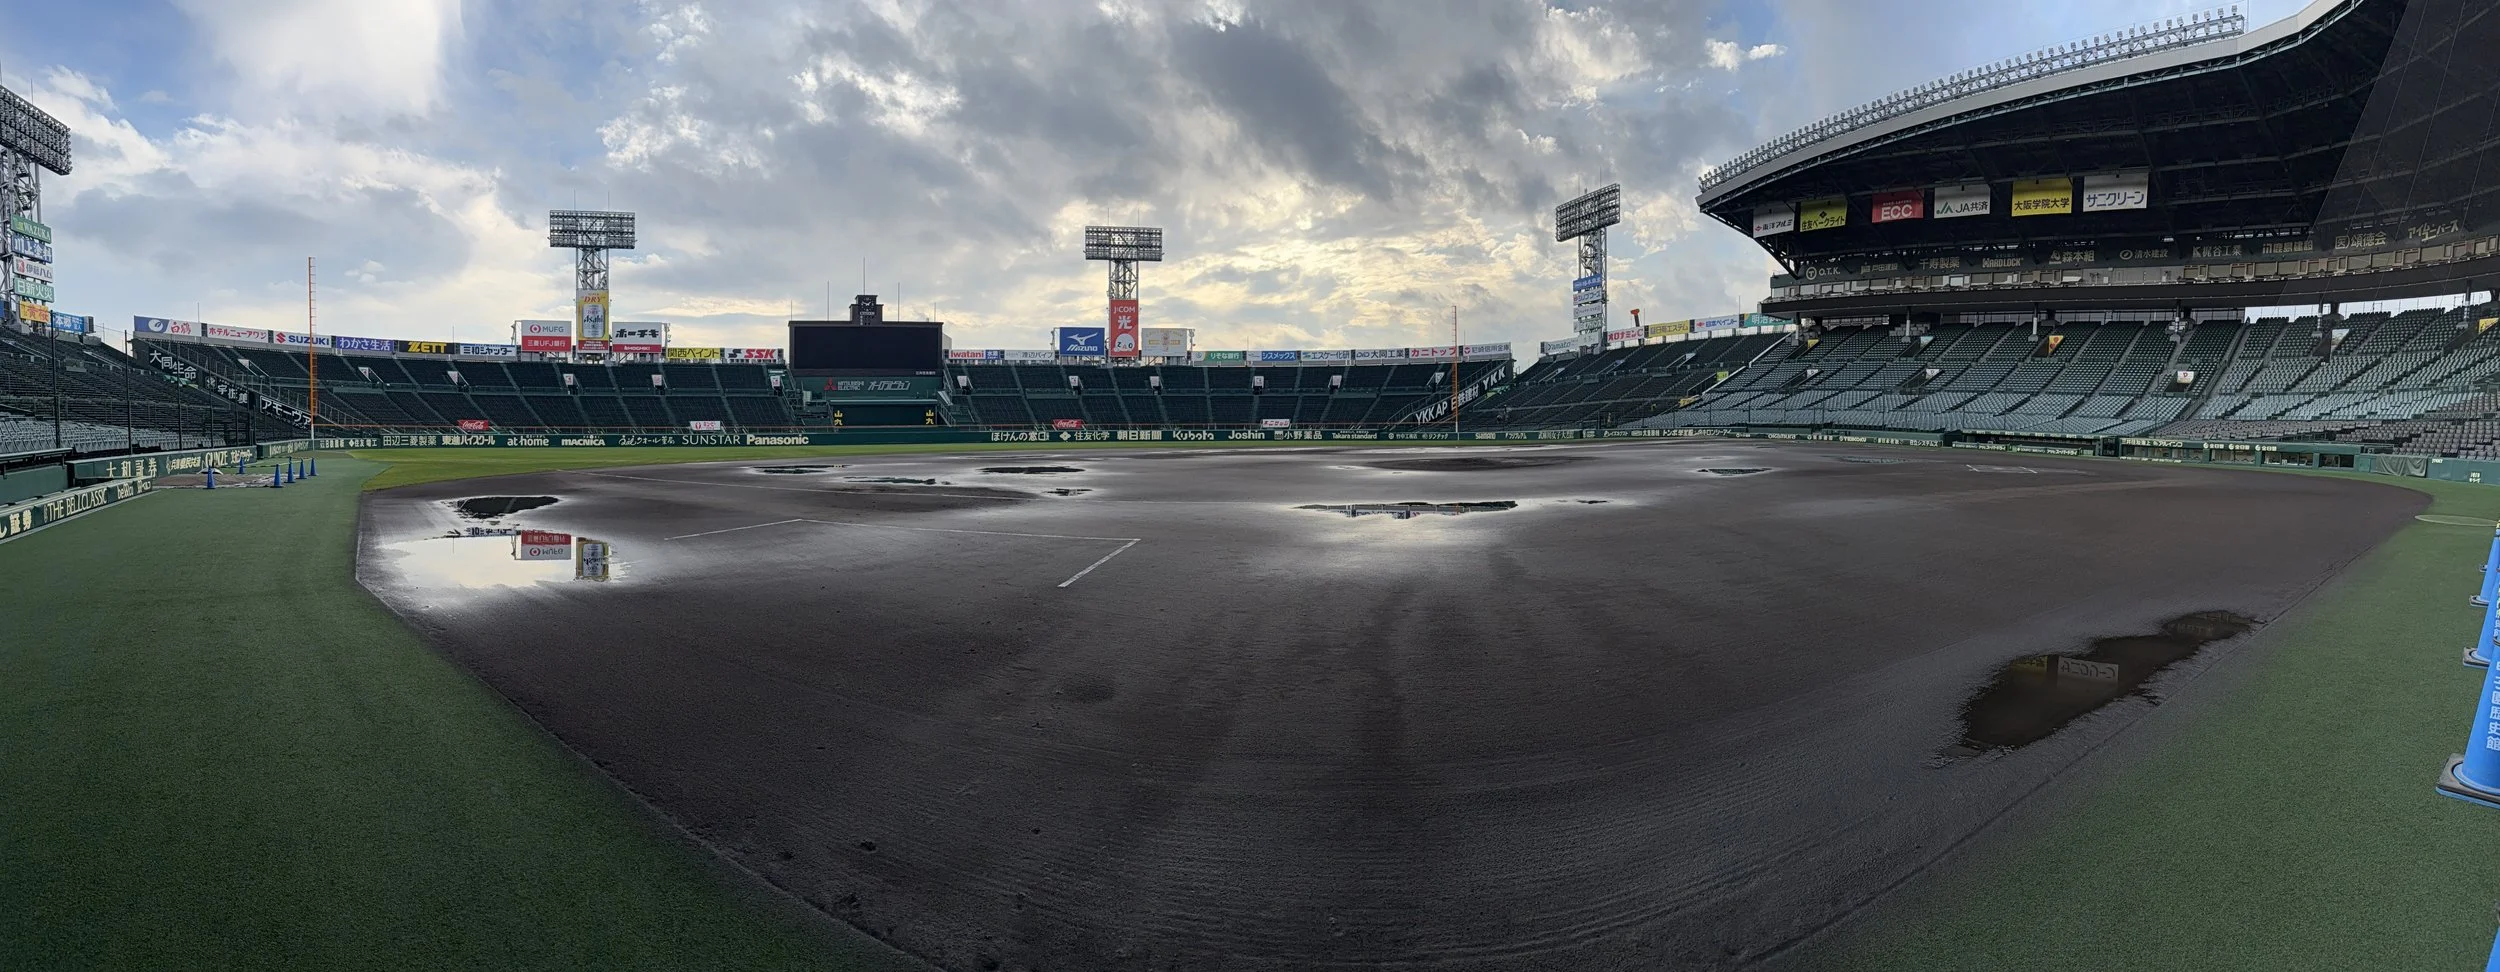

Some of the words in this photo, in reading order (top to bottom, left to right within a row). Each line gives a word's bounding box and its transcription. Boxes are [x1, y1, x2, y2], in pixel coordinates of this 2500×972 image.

[2014, 198, 2070, 211] 大阪学院大学
[2086, 191, 2144, 207] サニクリーン
[1881, 205, 1912, 220] ECC
[1955, 201, 1988, 213] JA共済
[1762, 219, 1792, 231] 東洋アルミ
[1801, 217, 1844, 231] 住友ベークライト
[2062, 250, 2095, 263] 森本組
[2134, 247, 2169, 259] 清水建設
[1872, 262, 1897, 273] 戸田建設
[1919, 256, 1960, 270] 千寿製薬
[26, 264, 52, 279] 伊藤ハム
[17, 281, 53, 300] 日新火災
[584, 315, 603, 323] Asahi
[1118, 316, 1132, 329] 光
[1706, 319, 1737, 328] 日本ペイント
[209, 327, 267, 340] ホテルニューアワジ
[616, 329, 659, 338] ホーチキ
[1608, 329, 1643, 341] オロナミンC
[288, 334, 330, 346] SUZUKI
[340, 338, 391, 350] わかさ生活
[408, 341, 447, 354] ZETT
[463, 346, 512, 356] 三和シャッター
[667, 348, 719, 358] 関西ペイント
[744, 349, 776, 358] SSK
[1472, 345, 1509, 353] 尼崎信用金庫
[1210, 352, 1239, 360] りそな銀行
[1262, 352, 1296, 360] シスメックス
[1311, 351, 1350, 359] エスケー化研
[1371, 350, 1404, 358] 大同工業
[150, 350, 197, 380] 大同生命
[1483, 366, 1506, 390] YKK
[218, 385, 247, 403] 宇佐美
[262, 397, 311, 425] アモーヴァ
[925, 409, 934, 424] 山九
[834, 410, 843, 426] 山九
[383, 436, 437, 446] 田辺三菱製薬
[442, 435, 495, 446] 東進ハイスクール
[682, 435, 740, 445] SUNSTAR
[746, 434, 810, 445] Panasonic
[991, 431, 1045, 441] ほけんの窓口
[1074, 431, 1110, 441] 住友化学
[1117, 431, 1162, 440] 朝日新聞
[1173, 430, 1214, 440] Kubota
[1228, 430, 1265, 440] Joshin
[1284, 430, 1322, 440] 小野薬品
[106, 457, 157, 478] 大和証券
[47, 499, 65, 522] THE
